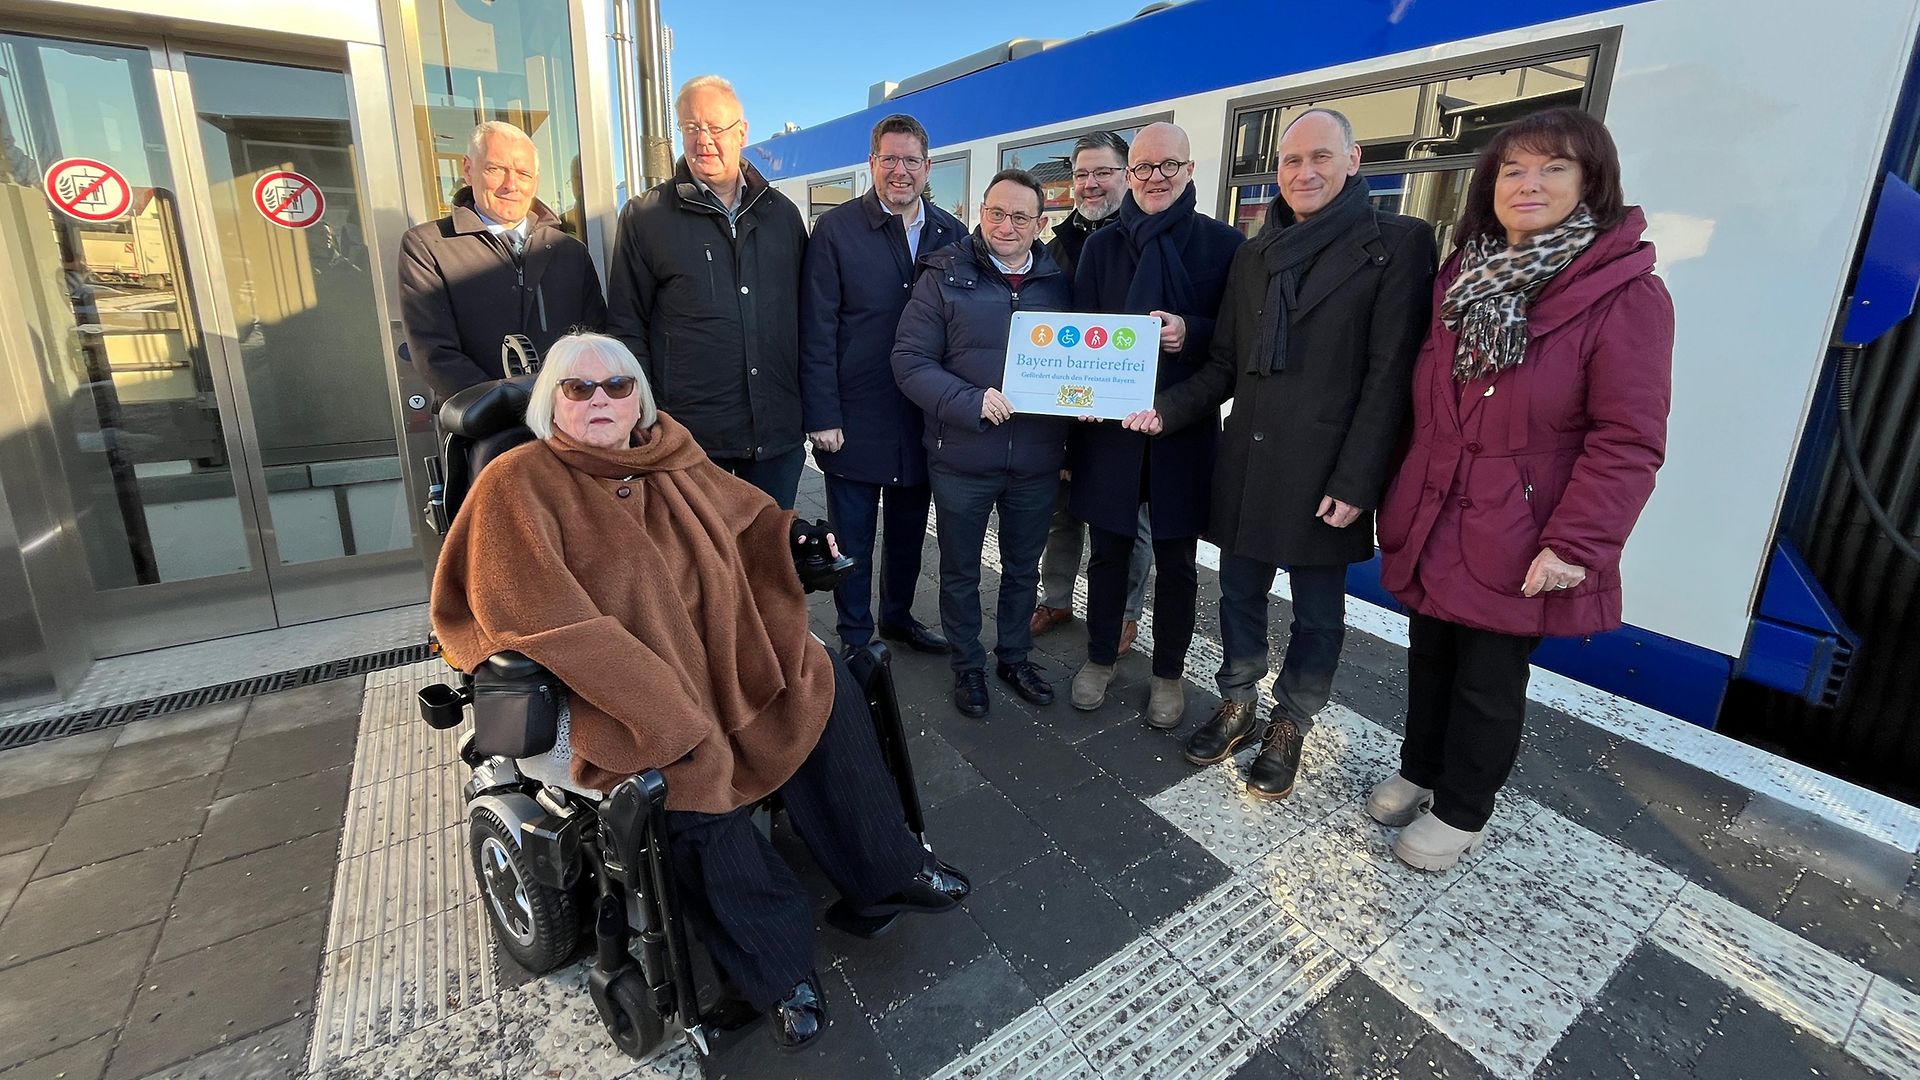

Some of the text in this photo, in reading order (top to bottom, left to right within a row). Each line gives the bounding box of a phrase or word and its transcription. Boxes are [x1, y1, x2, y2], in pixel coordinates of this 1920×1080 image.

[1016, 353, 1145, 372] Bayern barrierefrei
[1021, 371, 1051, 380] Gefördert
[1051, 373, 1070, 381] durch
[1084, 375, 1111, 383] Freistaat
[1112, 377, 1136, 385] Bayern.
